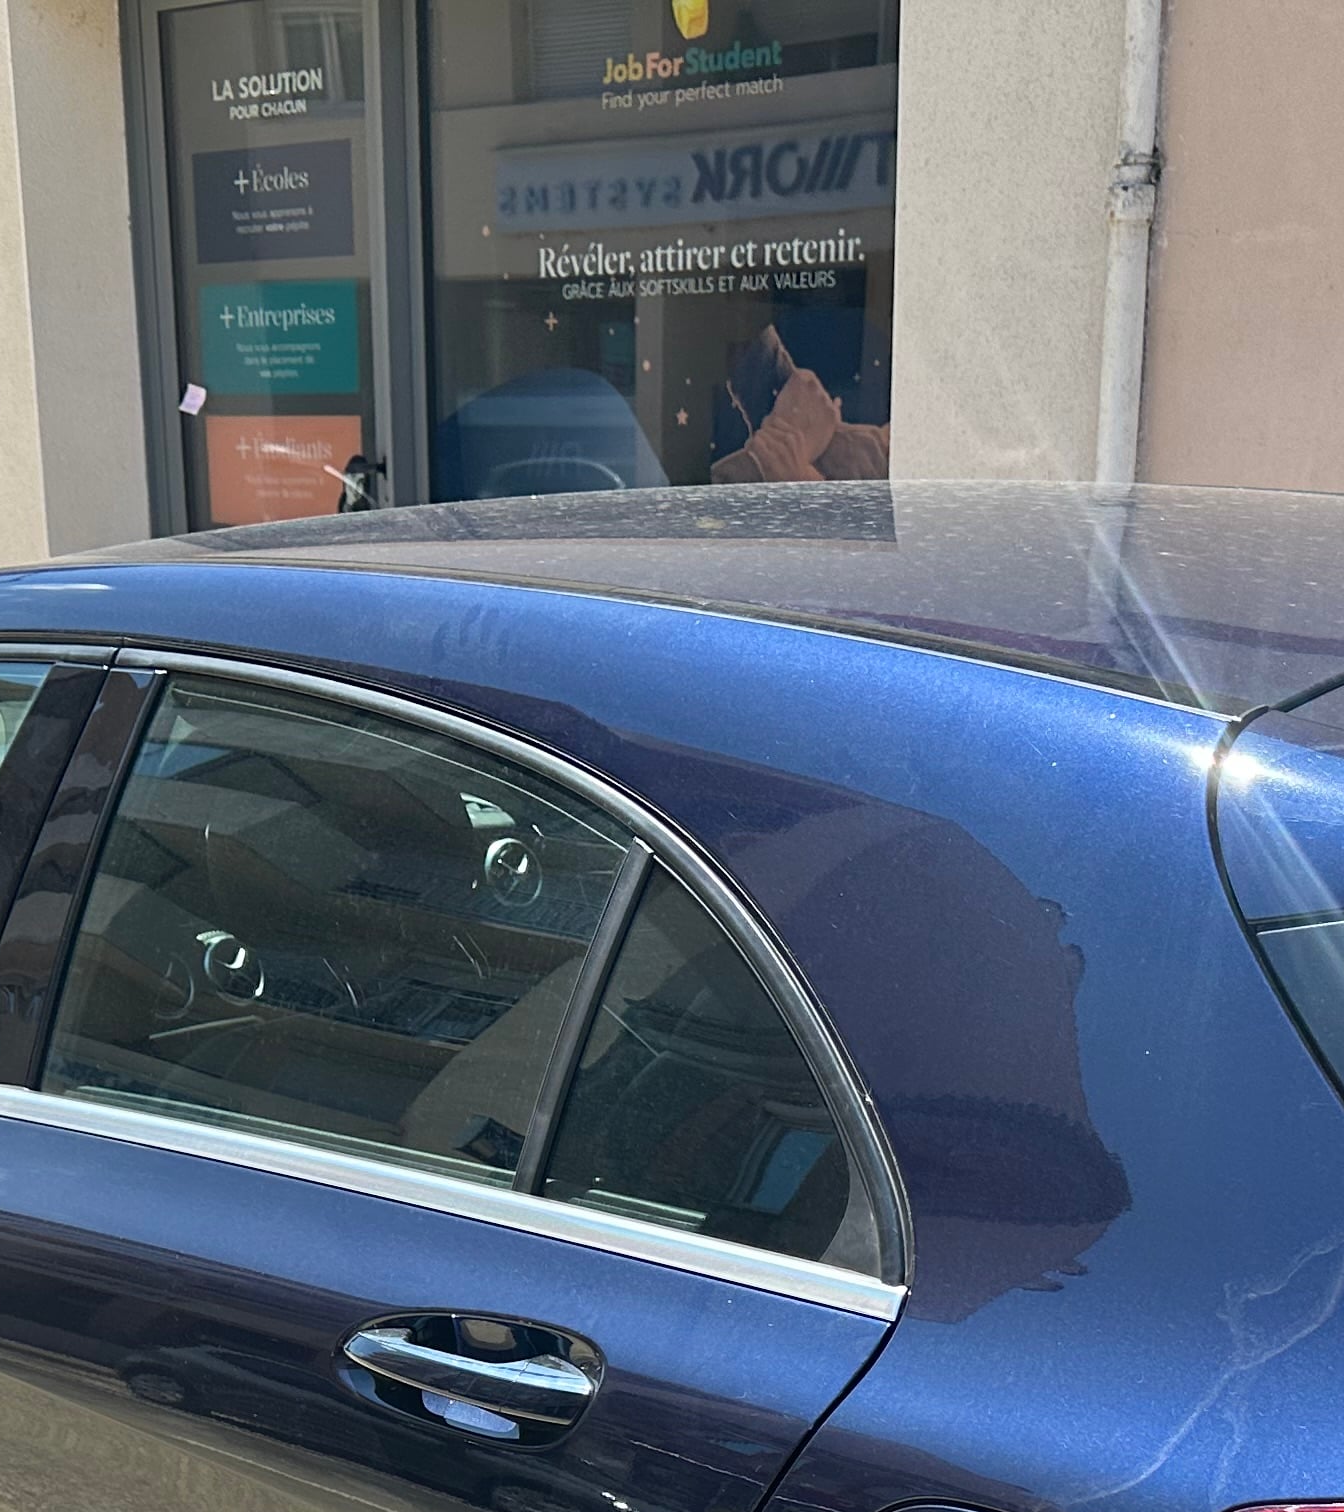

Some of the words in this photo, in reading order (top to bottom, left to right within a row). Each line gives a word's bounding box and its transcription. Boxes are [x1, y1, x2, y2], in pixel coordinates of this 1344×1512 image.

[602, 40, 783, 85] JobForStudent
[212, 79, 234, 102] LA
[238, 67, 324, 99] SOLUTION
[601, 91, 633, 110] Find
[638, 90, 670, 112] your
[675, 80, 733, 107] perfect
[736, 73, 784, 97] match
[229, 104, 260, 121] POUR
[261, 98, 307, 117] CHACUN
[539, 242, 635, 280] Révéler,
[640, 238, 726, 273] attirer
[731, 242, 756, 268] et
[764, 228, 866, 265] retenir.
[718, 275, 735, 292] ET
[740, 273, 770, 291] AUX
[774, 270, 837, 289] VALEURS
